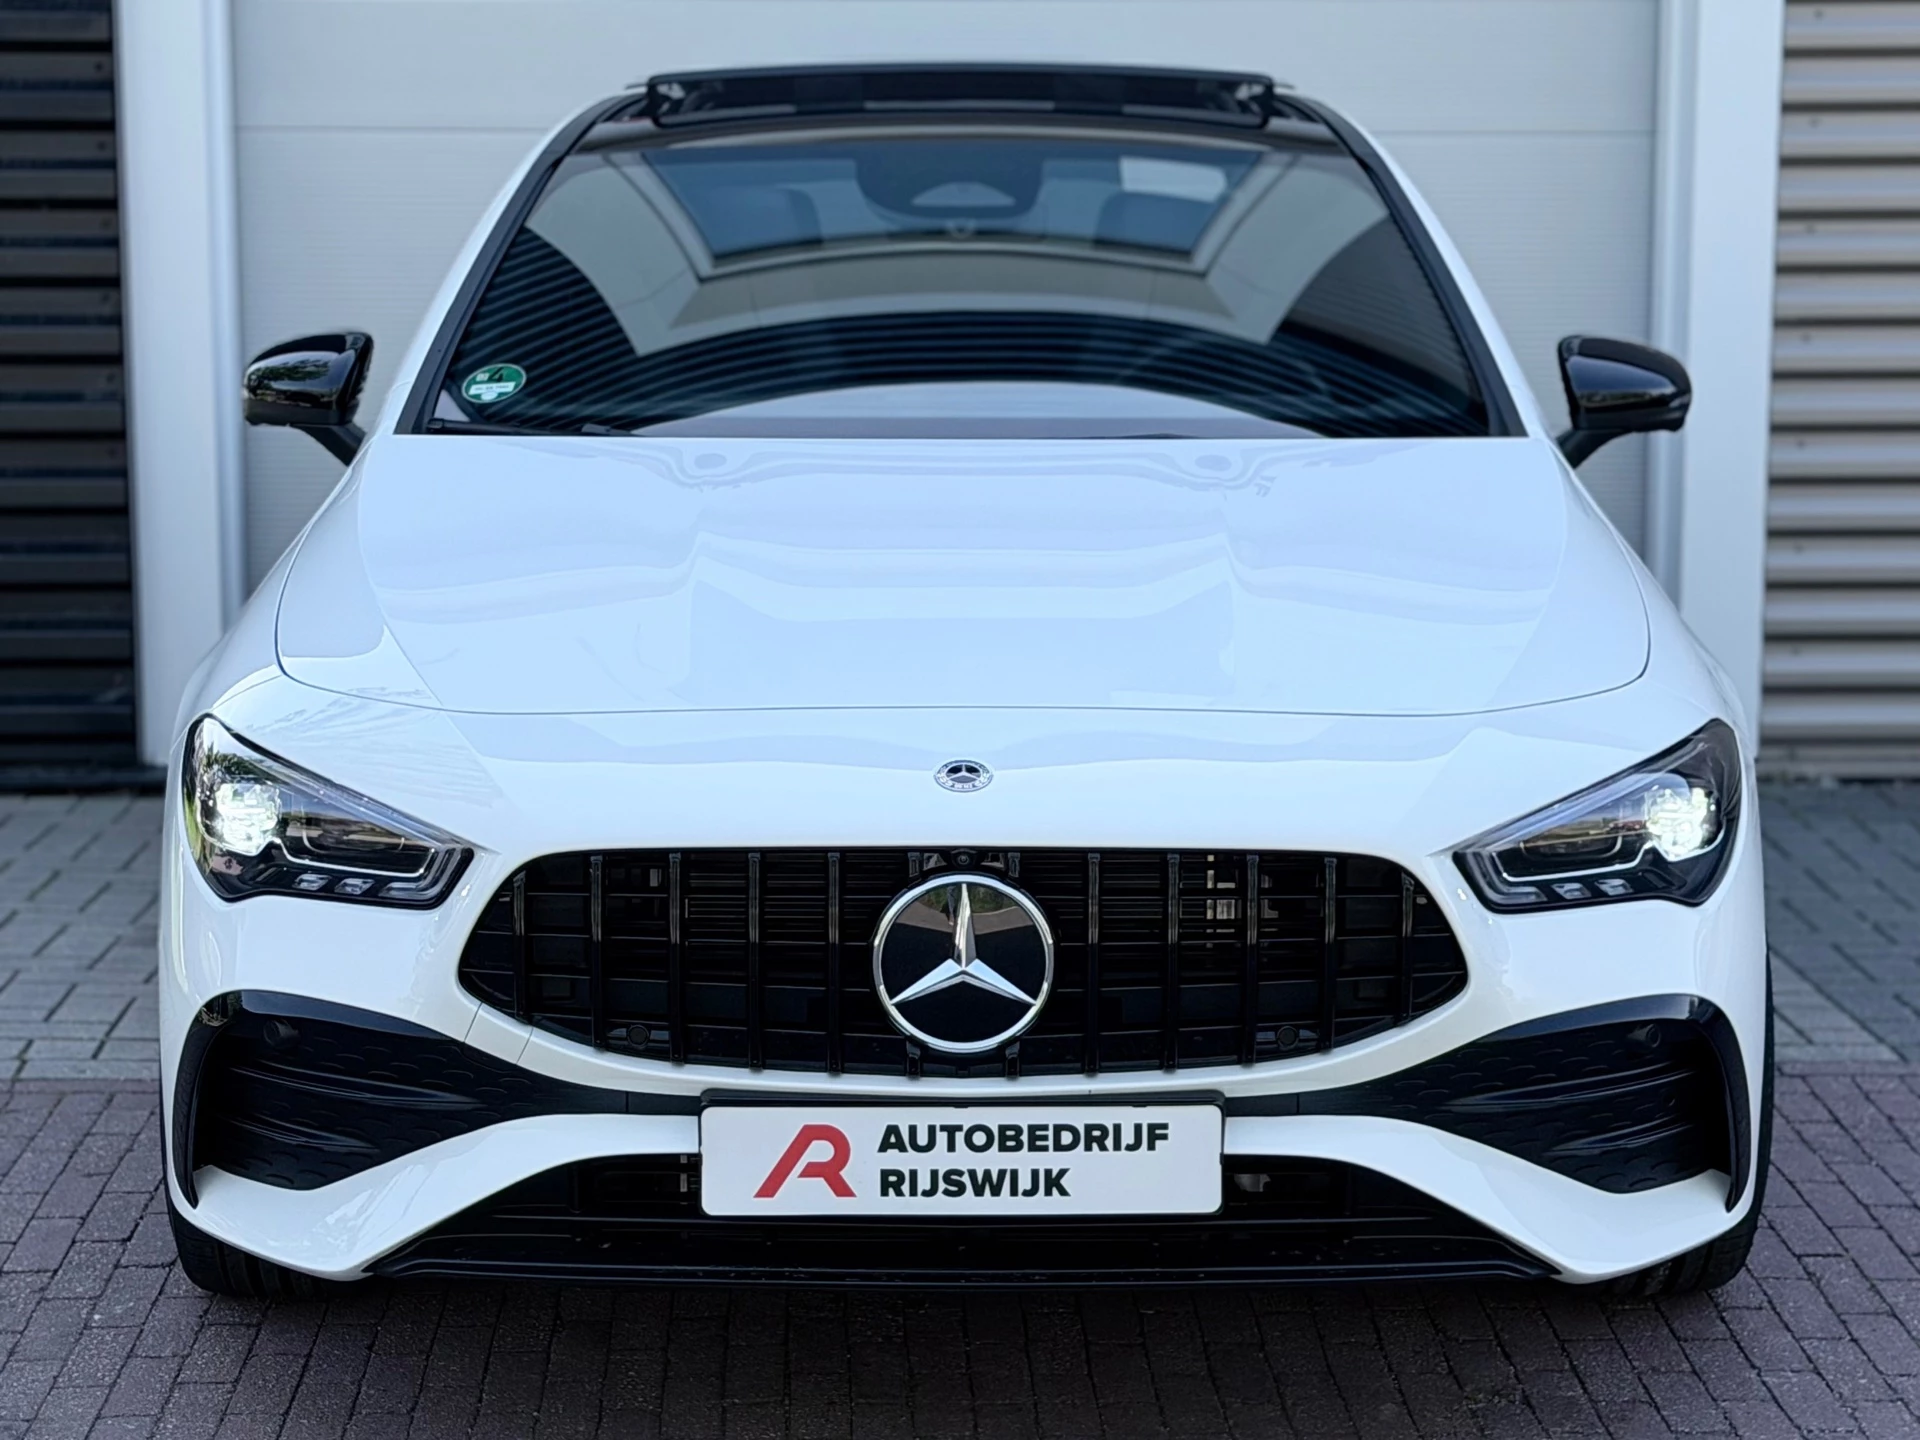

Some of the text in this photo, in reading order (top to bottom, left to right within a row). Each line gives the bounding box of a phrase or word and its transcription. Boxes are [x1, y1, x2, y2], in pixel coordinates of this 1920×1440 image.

[488, 367, 504, 382] 4
[878, 1123, 1169, 1153] AUTOBEDRIJF
[880, 1168, 1071, 1198] RIJSWIJK
